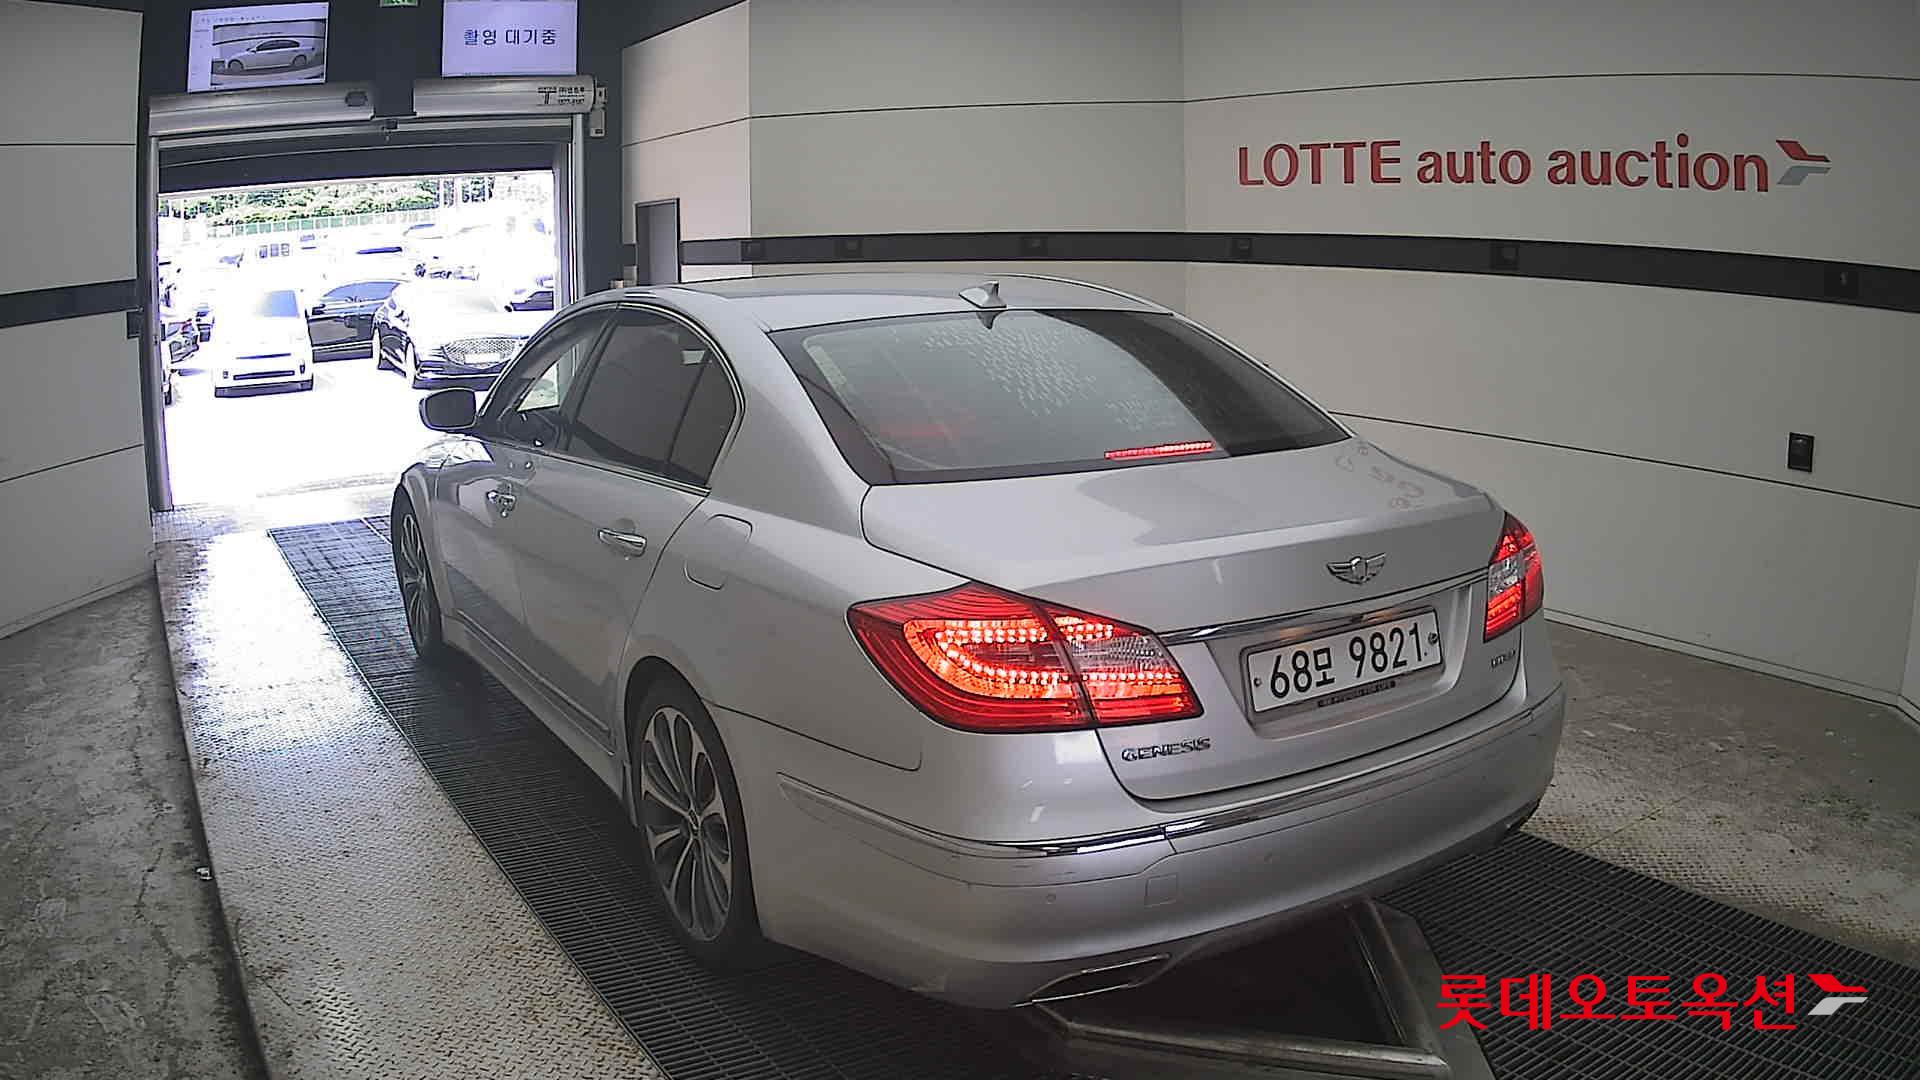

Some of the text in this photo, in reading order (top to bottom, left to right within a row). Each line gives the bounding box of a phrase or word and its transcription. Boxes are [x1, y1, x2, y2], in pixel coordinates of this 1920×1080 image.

[464, 29, 557, 46] 촬영 대기중
[1238, 132, 1769, 193] LOTTE auto auction
[1270, 647, 1335, 698] 68모
[1349, 622, 1423, 678] 9821
[1121, 737, 1212, 762] GENESIS
